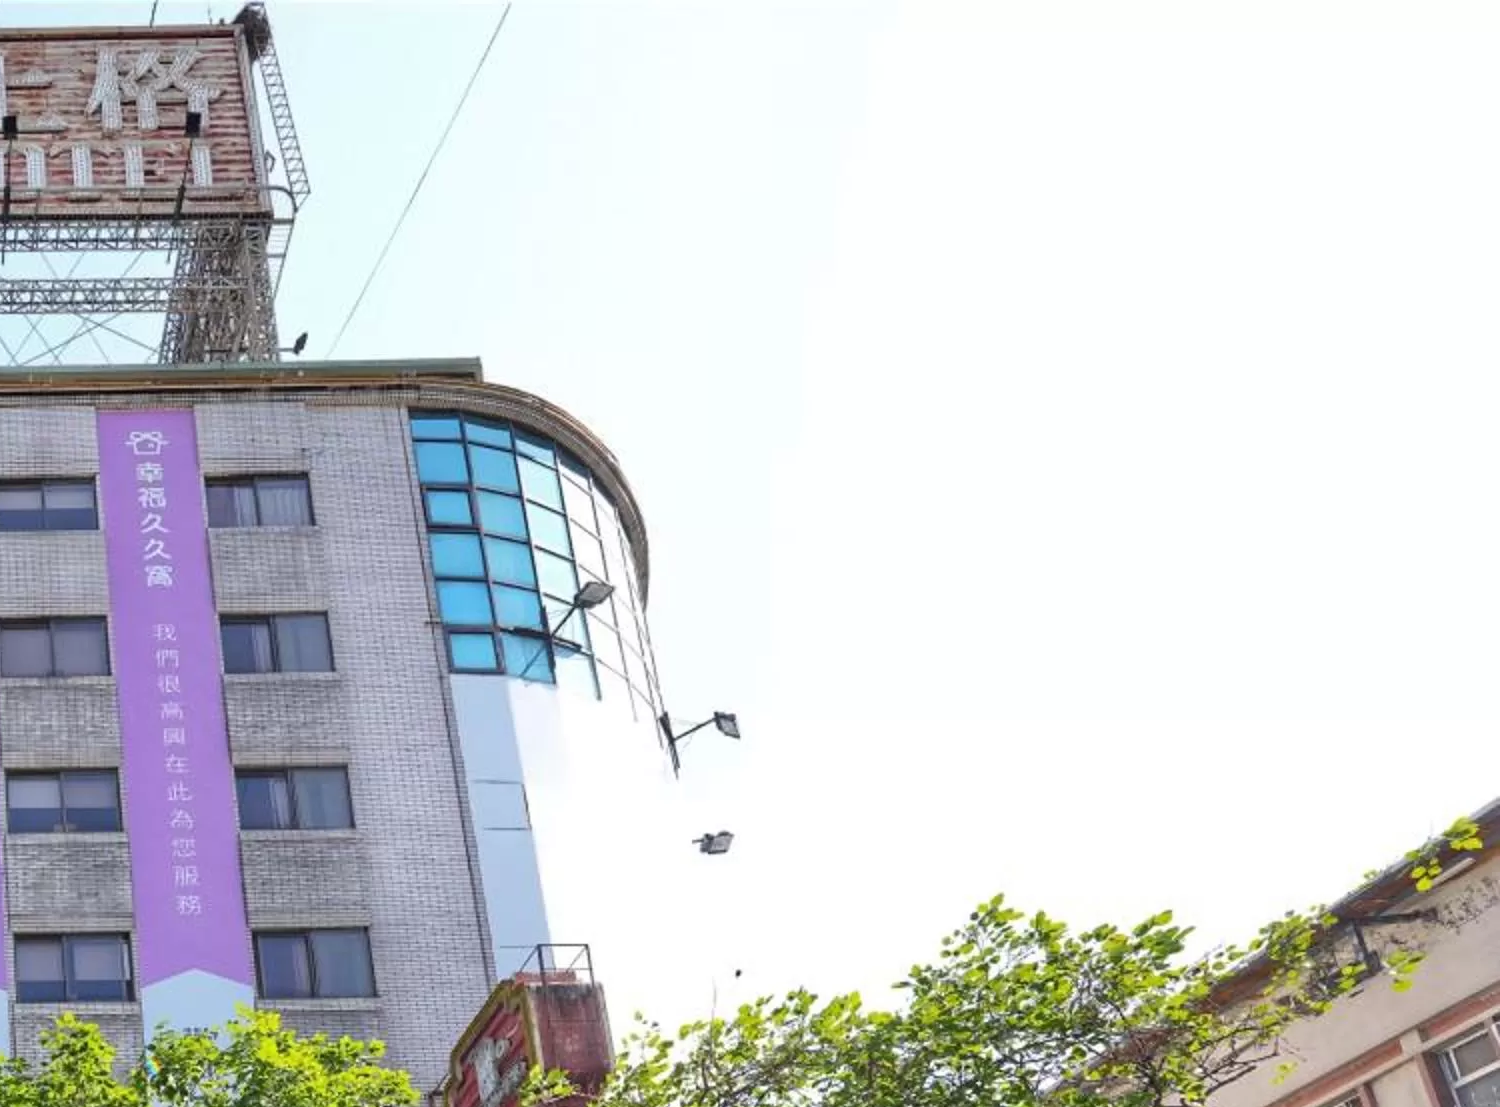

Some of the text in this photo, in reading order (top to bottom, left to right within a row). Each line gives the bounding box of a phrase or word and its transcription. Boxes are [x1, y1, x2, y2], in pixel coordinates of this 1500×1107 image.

[136, 463, 174, 588] 幸福久久窩
